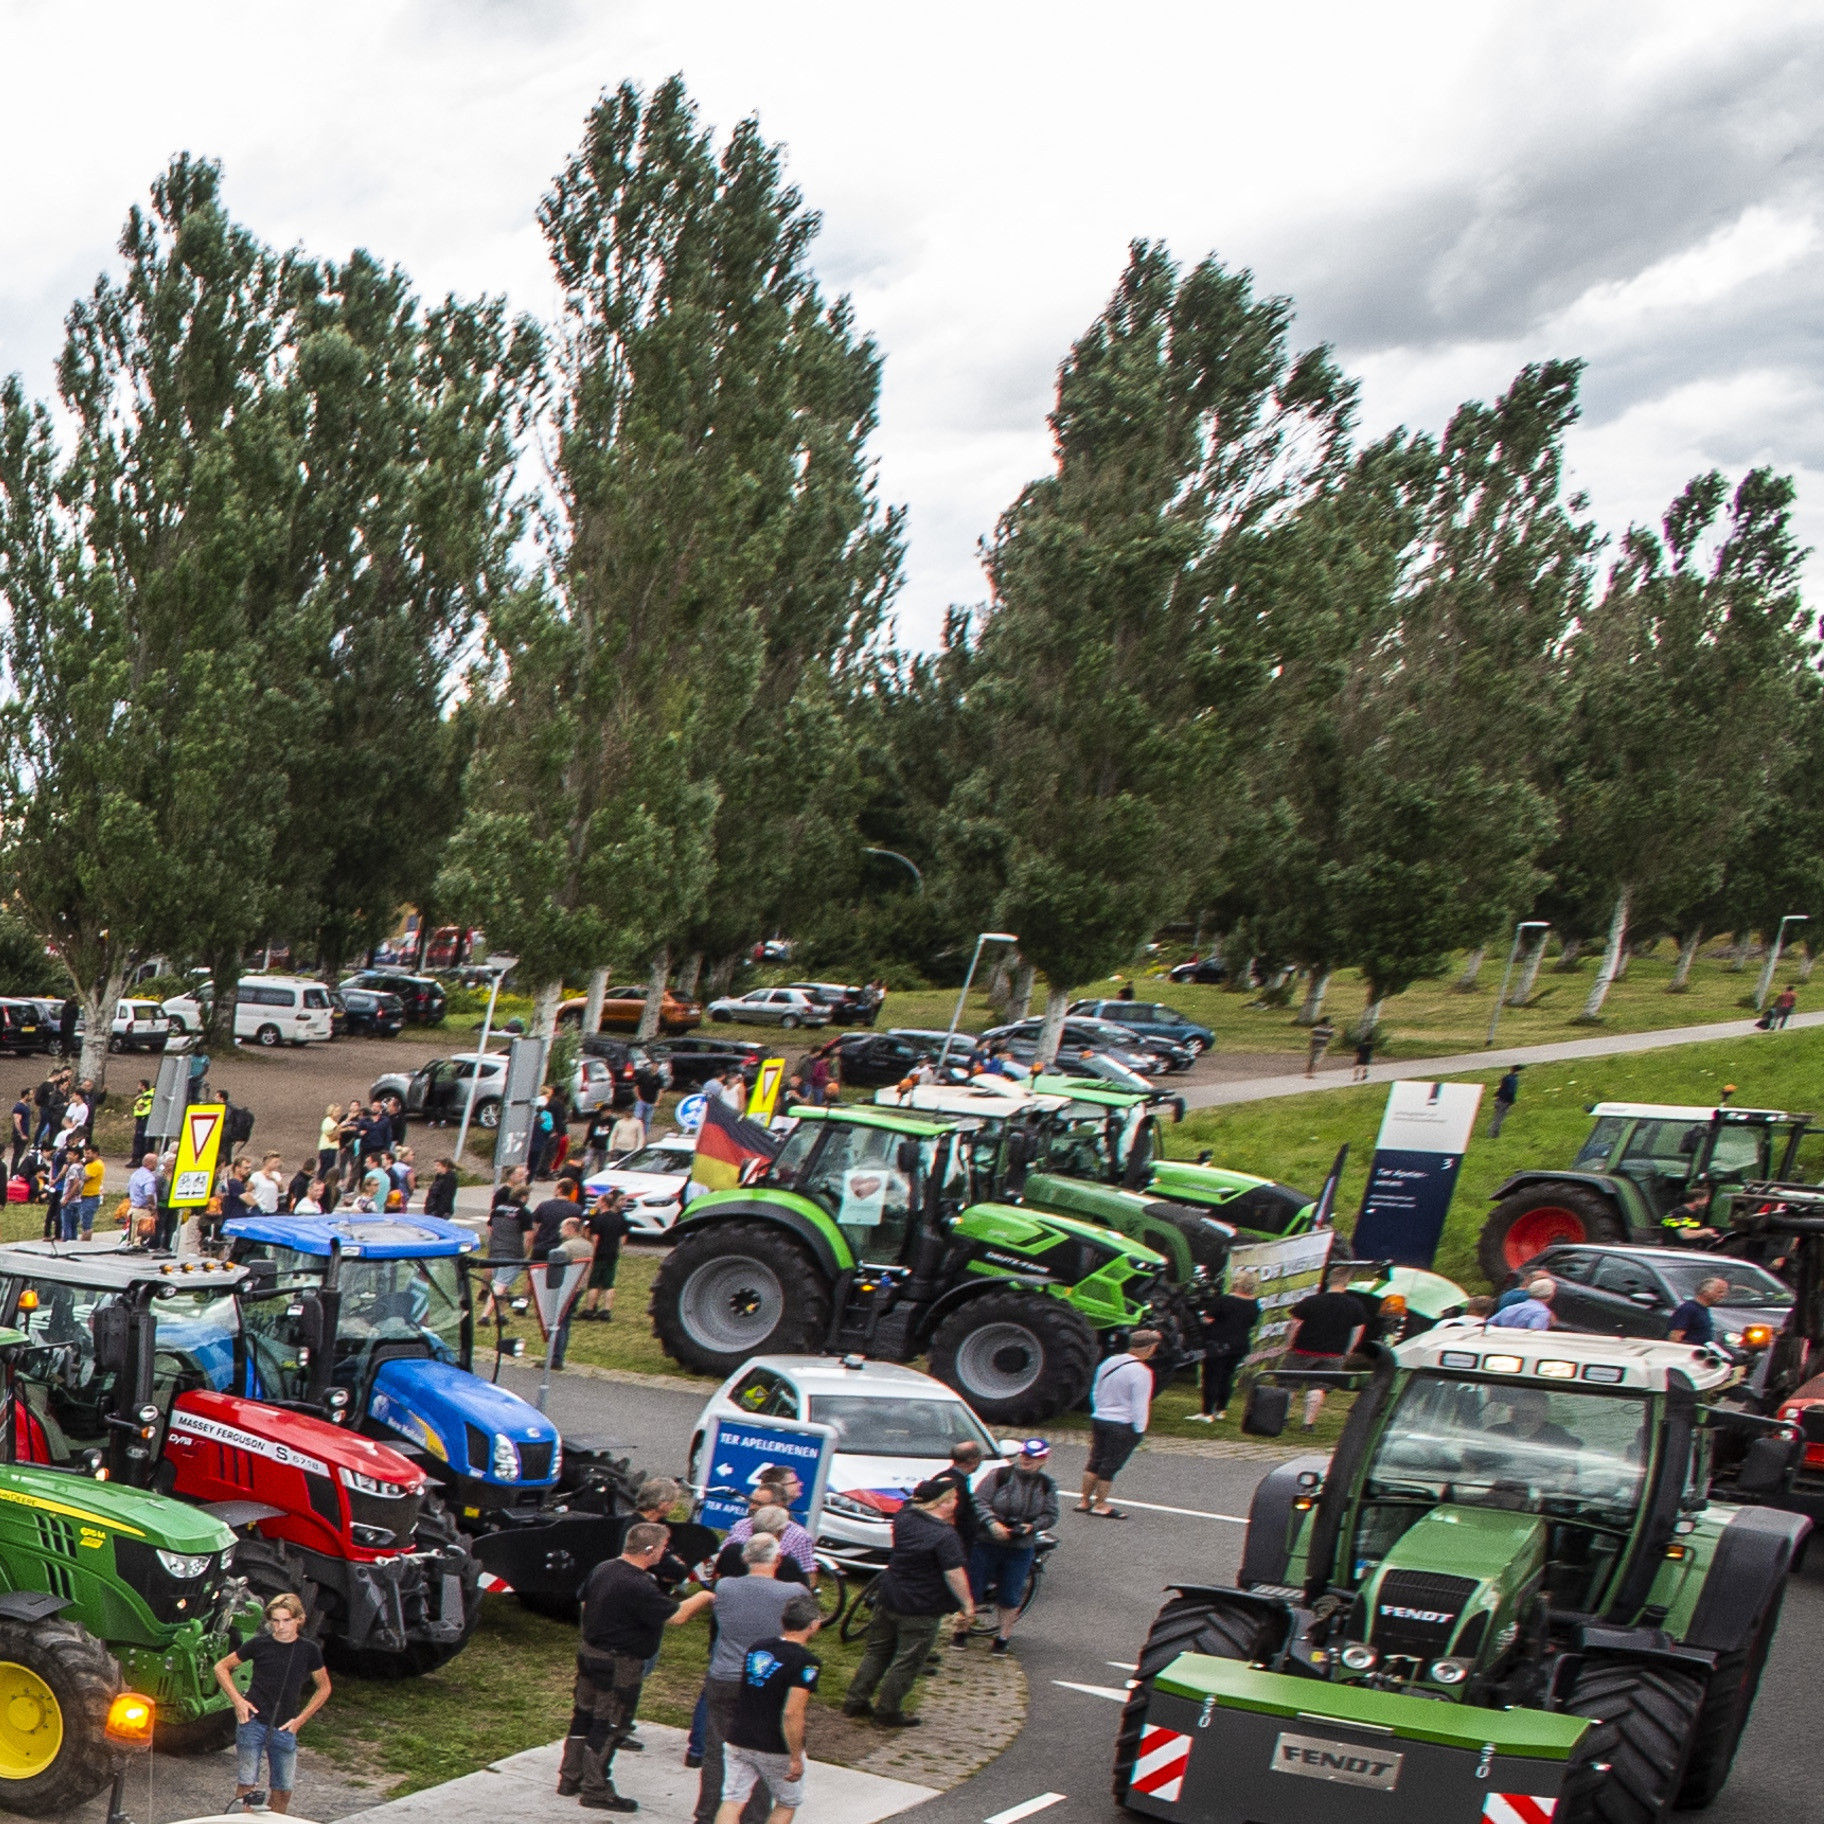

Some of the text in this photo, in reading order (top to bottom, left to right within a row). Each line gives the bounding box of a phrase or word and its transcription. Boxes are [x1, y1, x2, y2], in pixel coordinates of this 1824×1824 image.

[178, 1415, 214, 1435] MASSEY
[216, 1427, 266, 1452] FERGUSON
[276, 1446, 288, 1462] S
[720, 1432, 741, 1445] TER
[11, 1493, 37, 1507] DEERE
[1380, 1604, 1455, 1624] FENDT
[1281, 1745, 1395, 1777] FENDT
